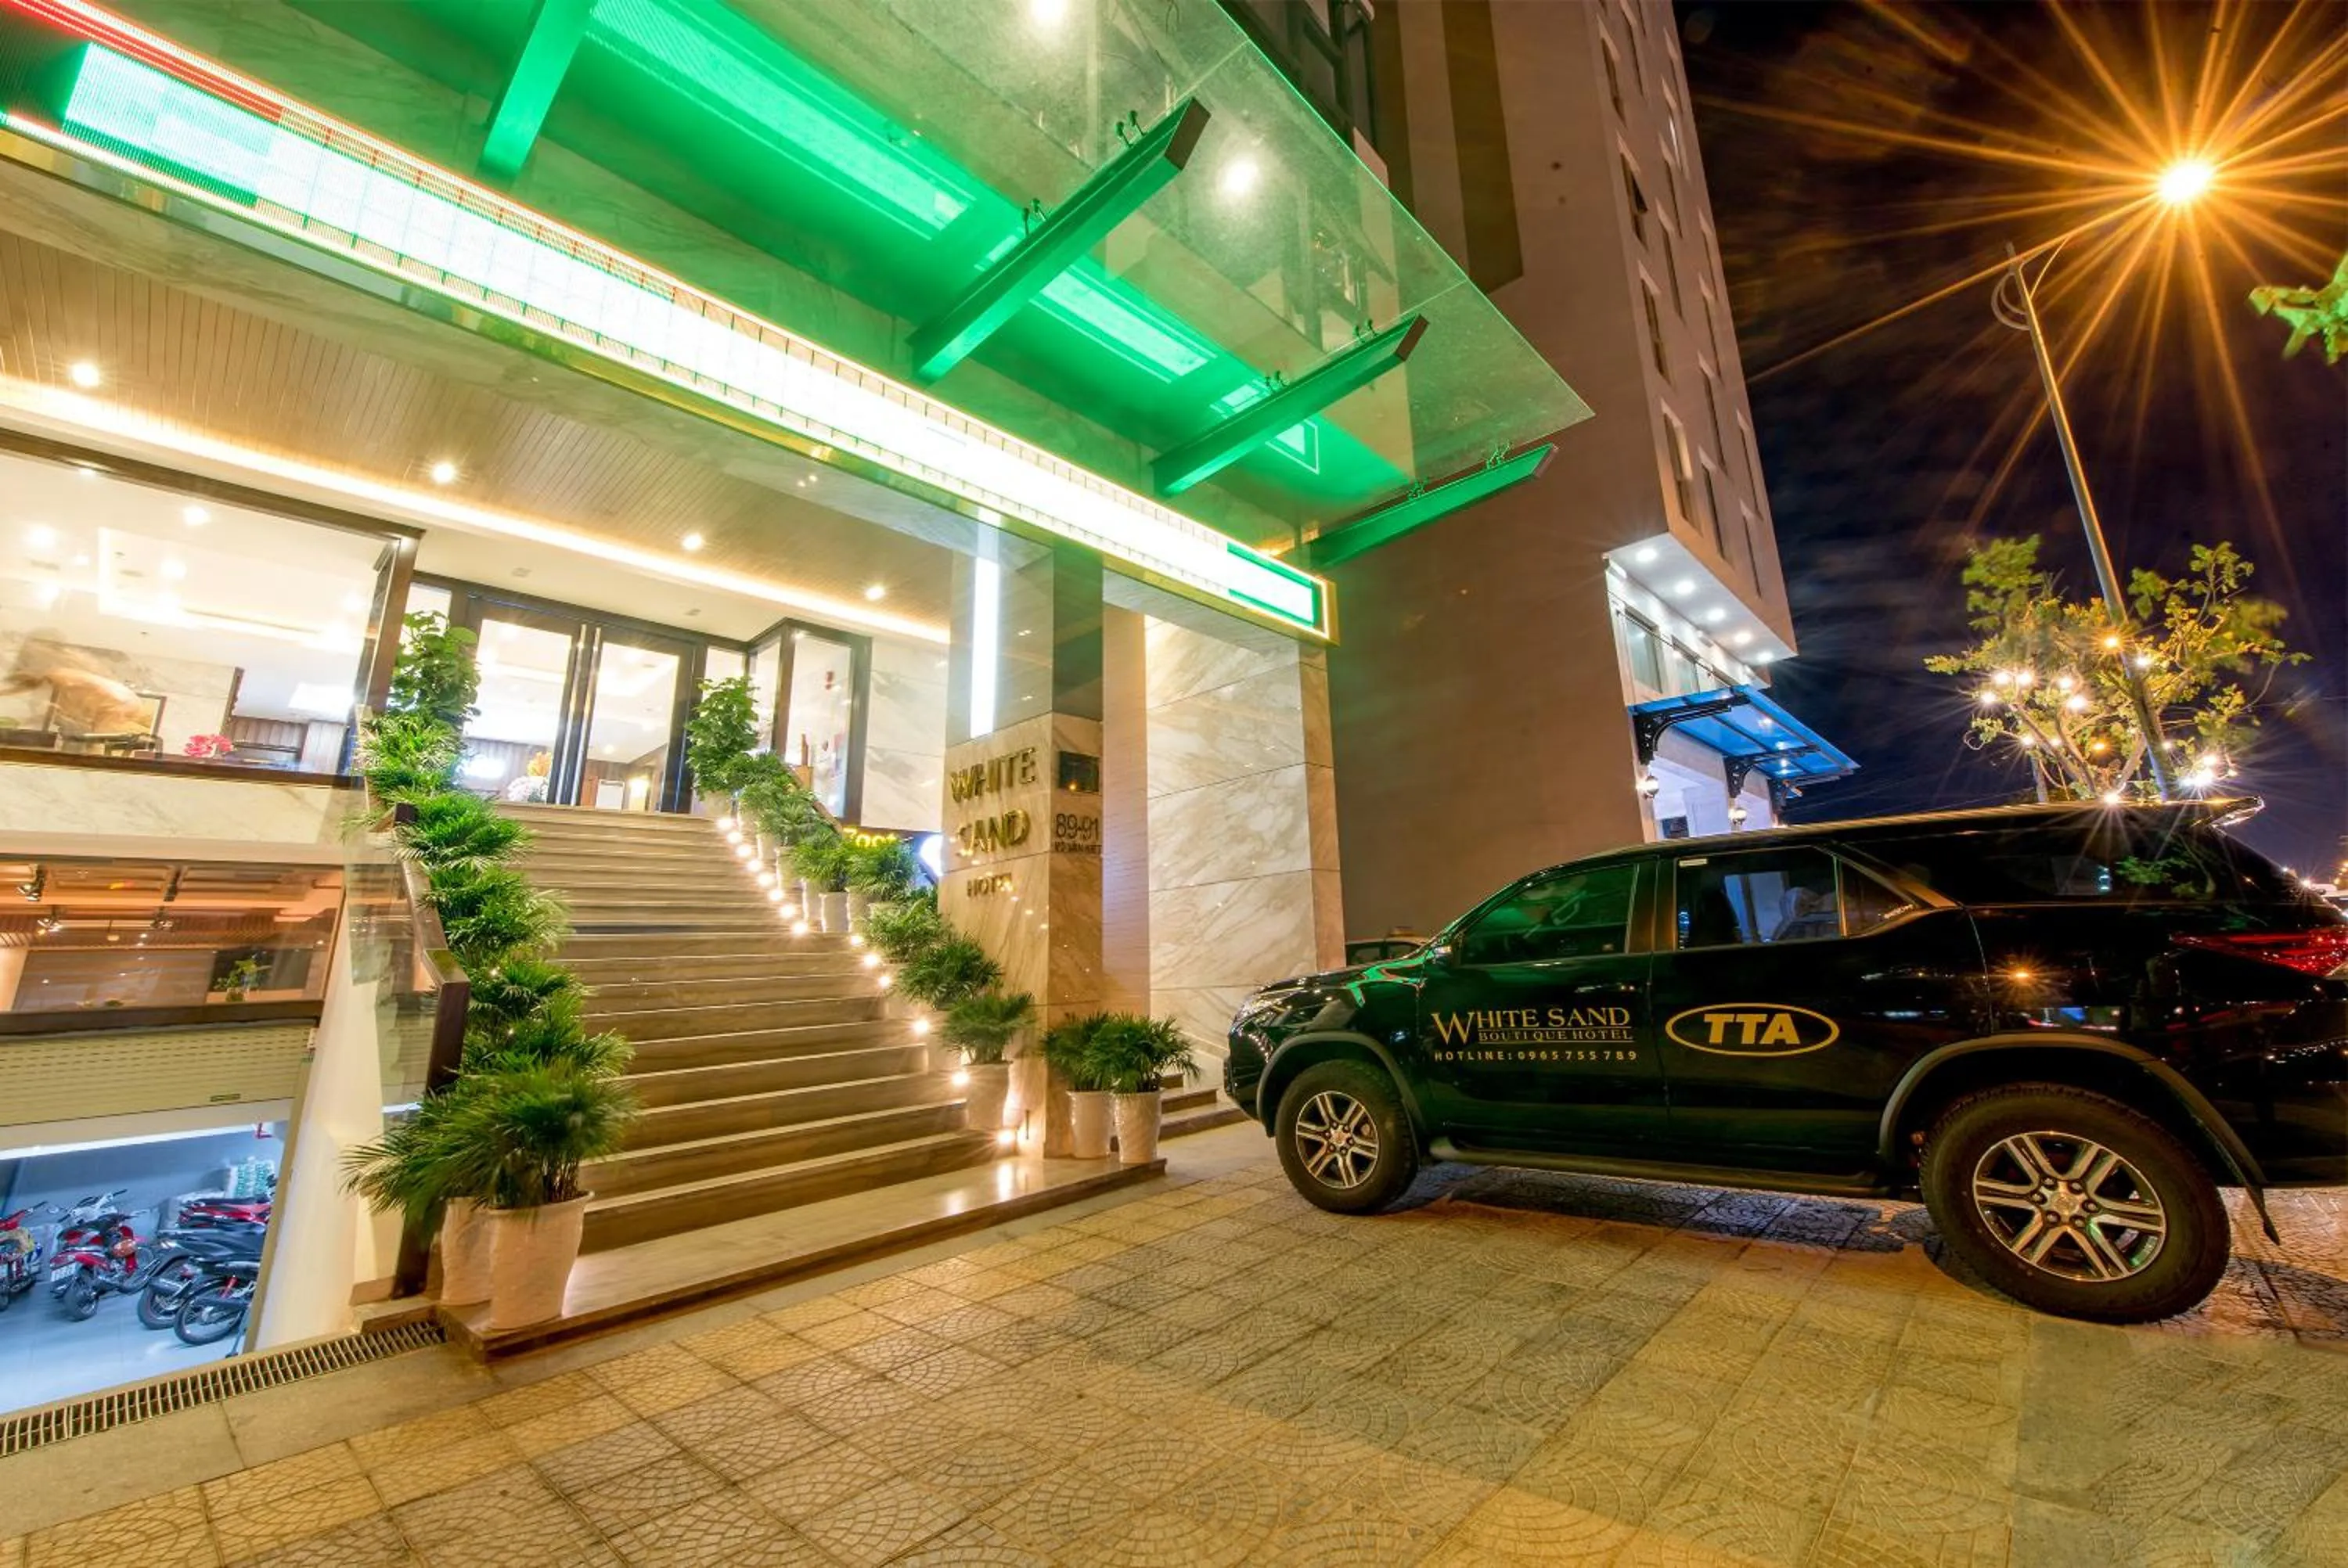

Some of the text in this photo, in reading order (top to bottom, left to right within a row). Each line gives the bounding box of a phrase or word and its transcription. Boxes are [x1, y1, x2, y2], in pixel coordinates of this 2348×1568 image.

[949, 746, 1037, 804] WHITE
[956, 808, 1032, 858] SAND
[1431, 1006, 1630, 1045] WHITE SAND
[1478, 1029, 1633, 1043] BOUTIQUE HOTEL
[1703, 1012, 1801, 1045] TTA
